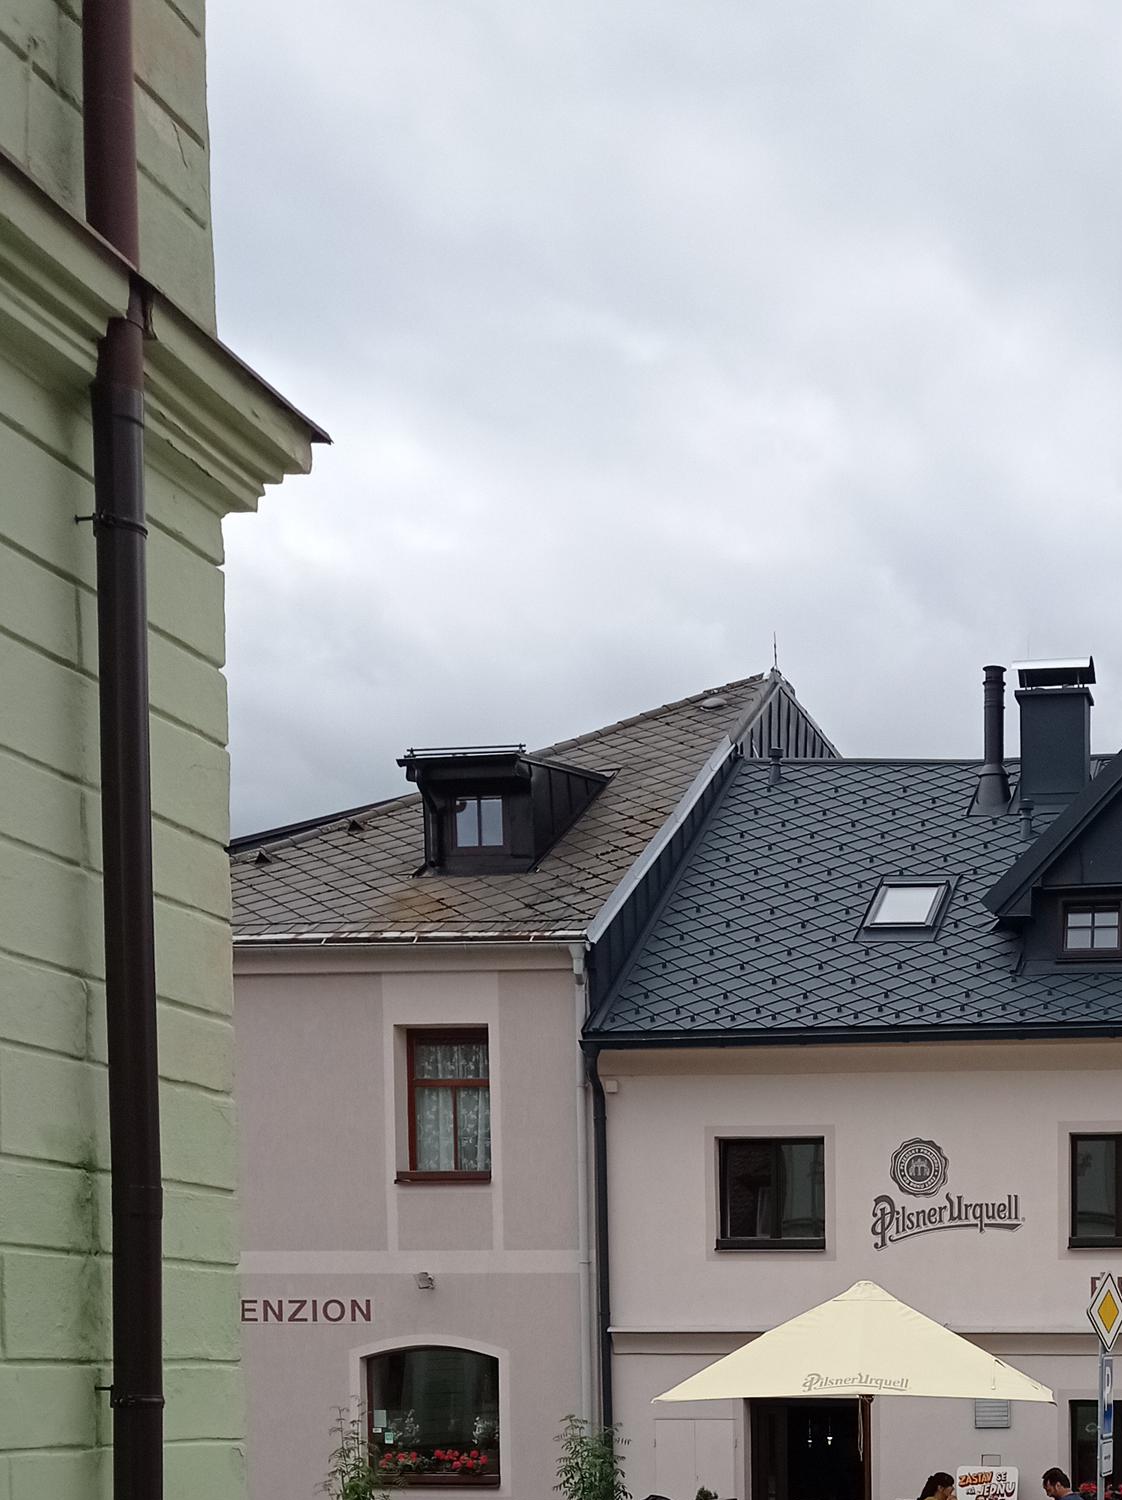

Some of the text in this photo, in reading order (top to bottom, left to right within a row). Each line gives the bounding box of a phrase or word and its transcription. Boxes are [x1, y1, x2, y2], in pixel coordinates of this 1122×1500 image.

[871, 1192, 1019, 1249] Pilsner Urquell
[801, 1372, 909, 1392] Pilsner Urquell
